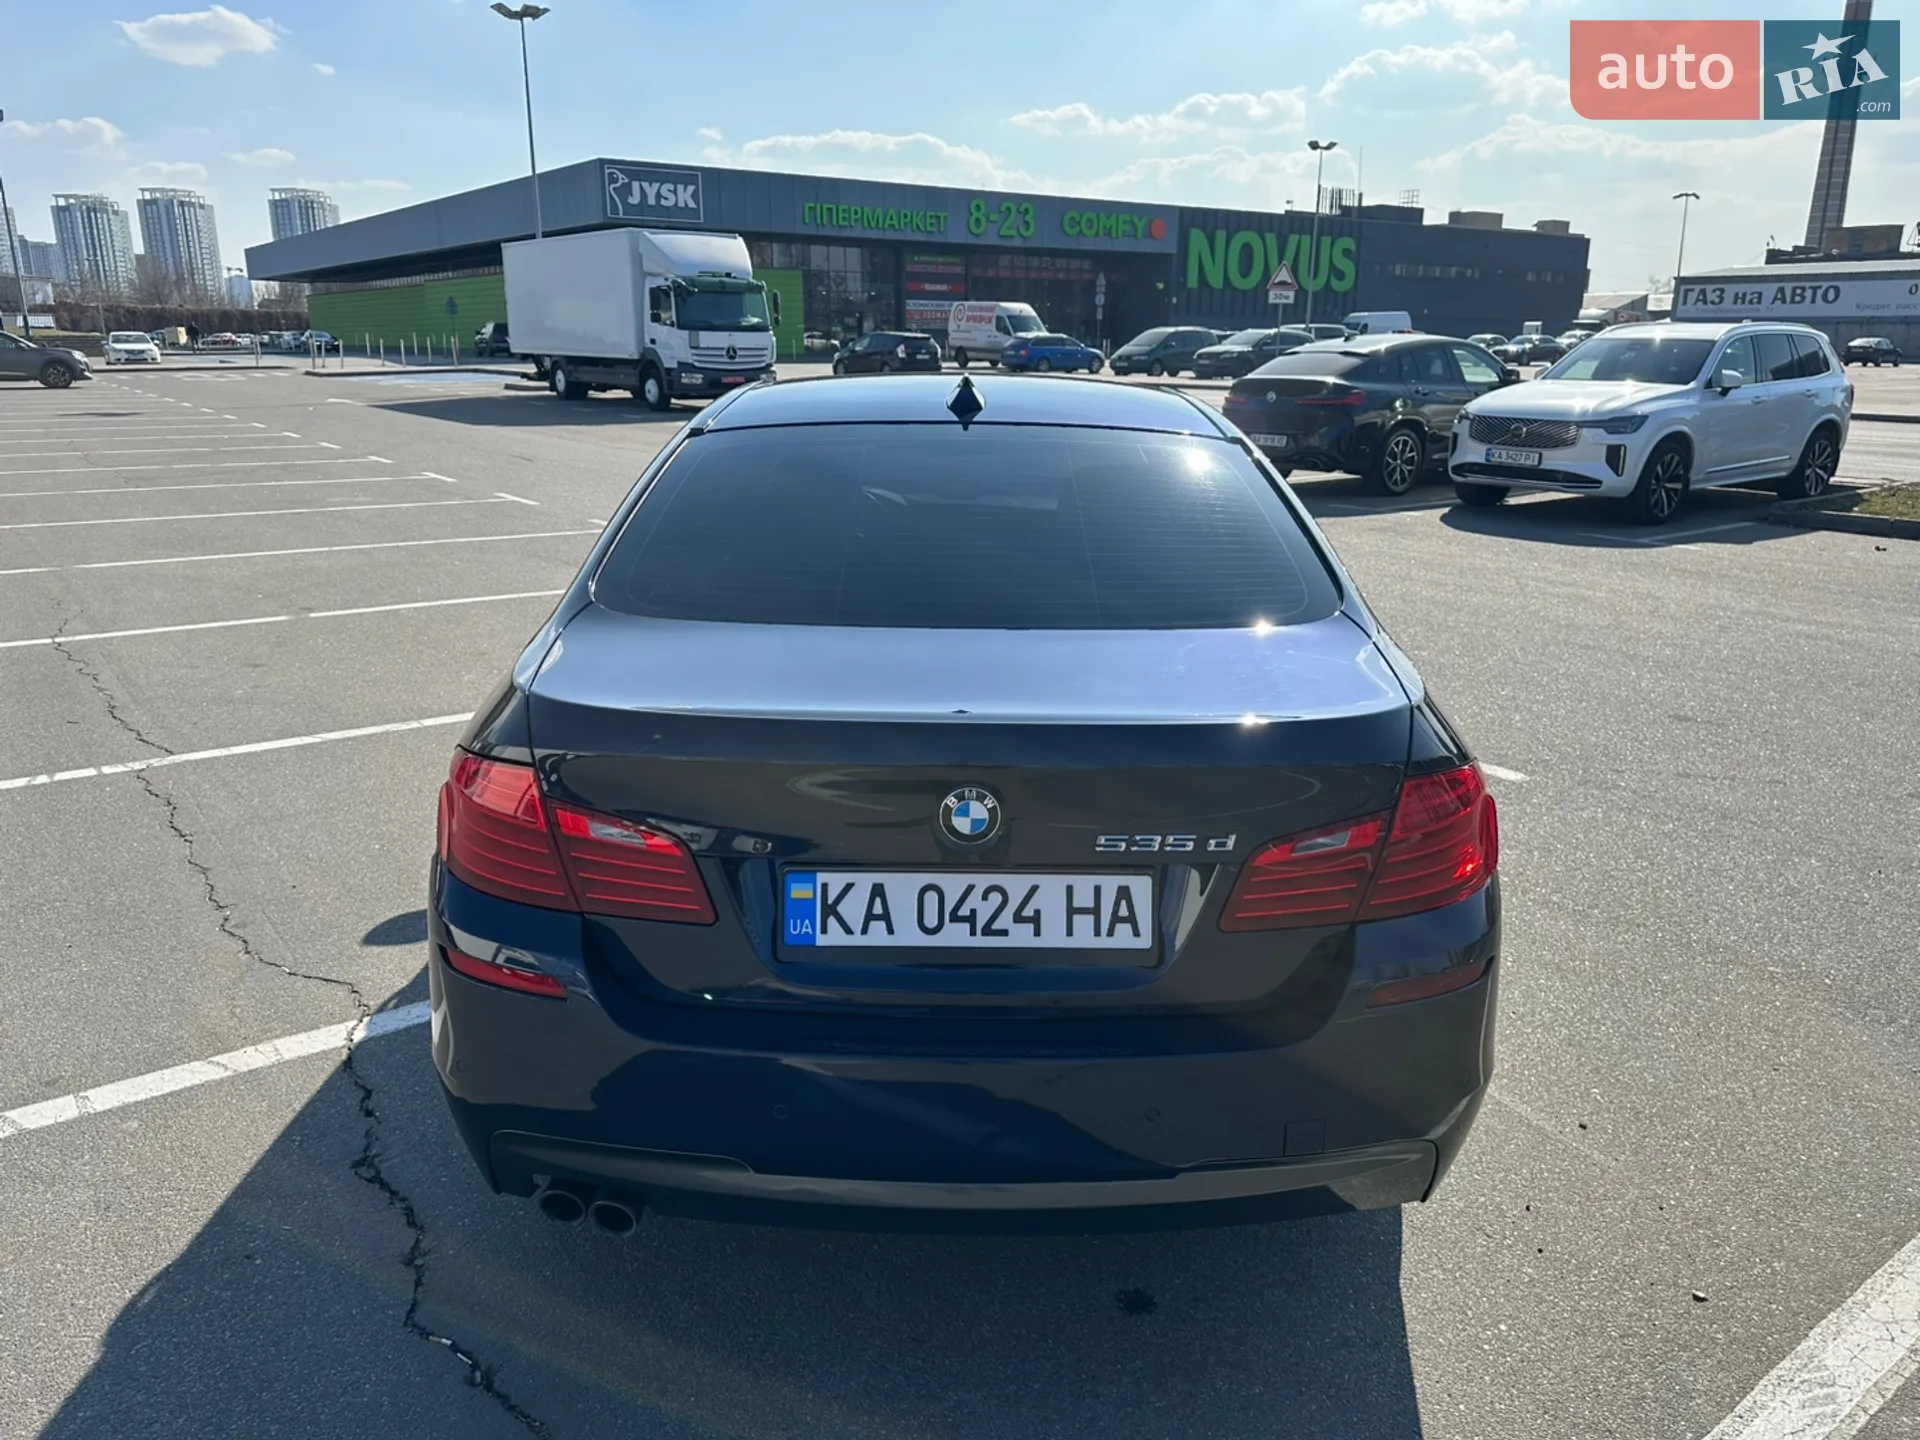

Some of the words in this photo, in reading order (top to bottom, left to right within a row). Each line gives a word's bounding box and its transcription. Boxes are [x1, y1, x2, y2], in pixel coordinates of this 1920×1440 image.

[627, 181, 697, 208] JYSK
[804, 202, 948, 232] ГІПЕРМАРКЕТ
[968, 198, 1035, 238] 8-23
[1062, 209, 1149, 240] COMFY
[1187, 228, 1356, 292] NOVUS
[1680, 287, 1726, 306] ГАЗ
[1732, 289, 1763, 305] на
[1770, 284, 1841, 305] АВТО
[946, 789, 997, 809] BMW
[1094, 834, 1198, 852] 535
[1207, 834, 1237, 852] d
[819, 882, 895, 935] KA
[916, 883, 1042, 937] 0424
[1065, 884, 1141, 937] HA
[789, 919, 813, 935] UA
